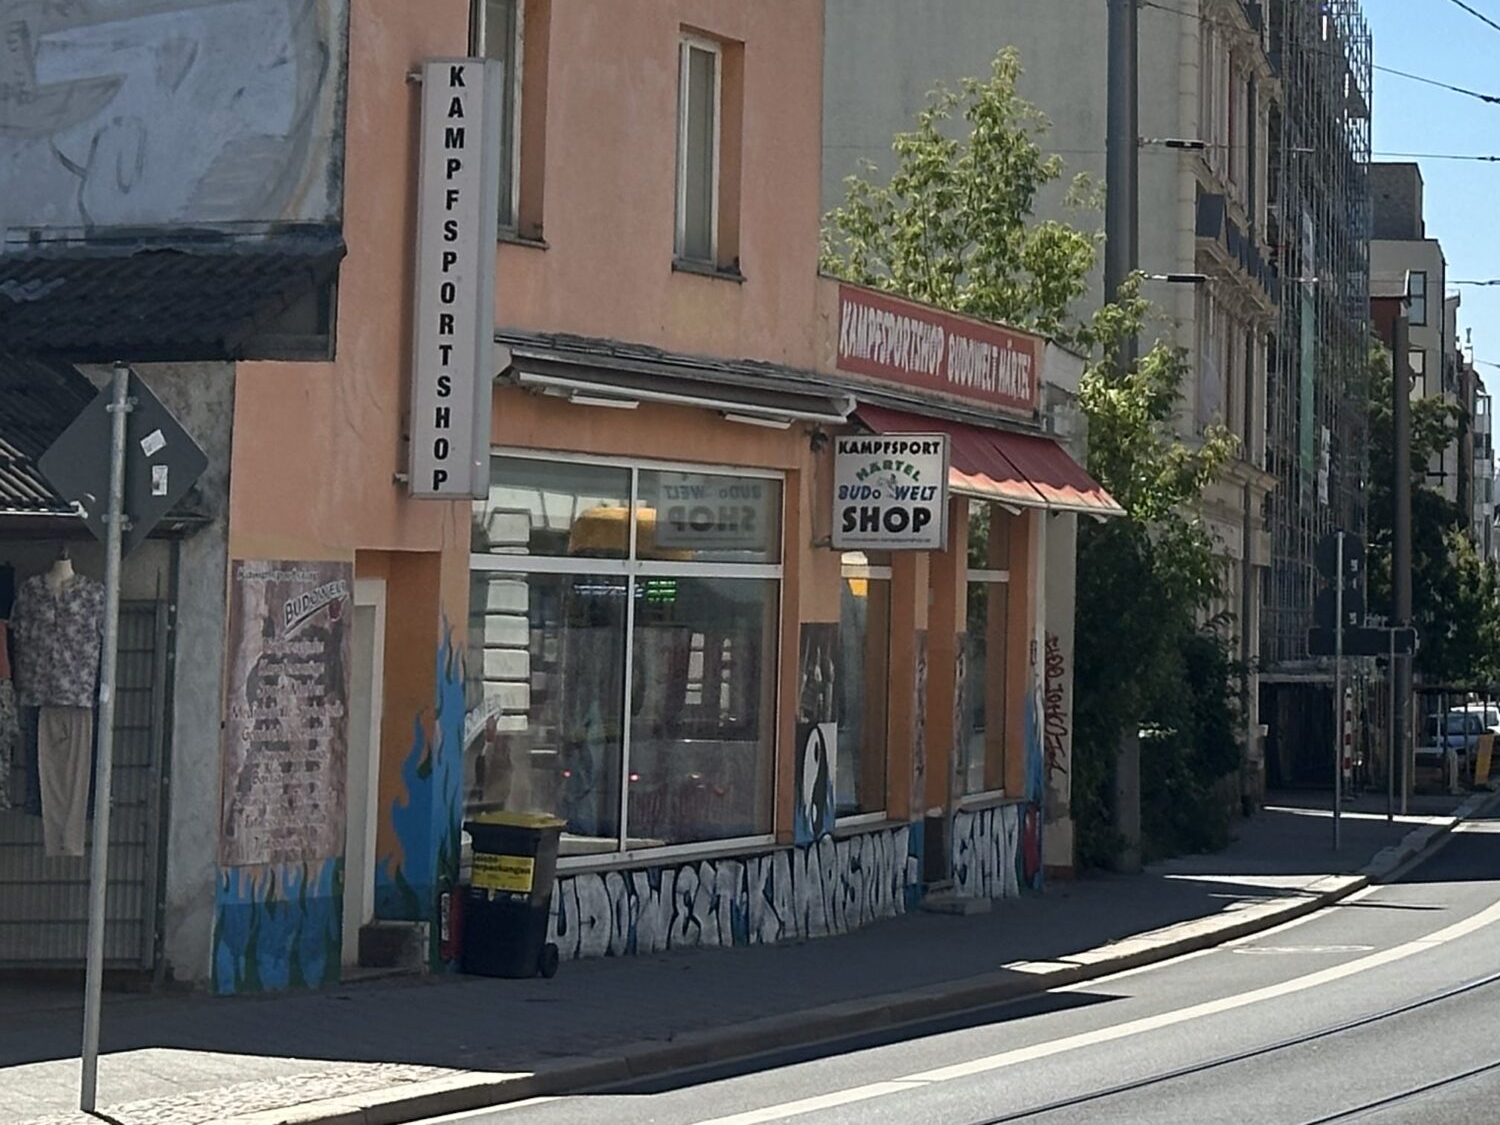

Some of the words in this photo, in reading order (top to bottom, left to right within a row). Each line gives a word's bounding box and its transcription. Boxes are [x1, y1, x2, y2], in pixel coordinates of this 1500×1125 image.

[431, 64, 465, 493] KAMPFSPORTSHOP
[839, 299, 944, 377] KAMPFSPORTSHOP
[838, 440, 941, 455] KAMPFSPORT
[894, 485, 938, 501] WELT
[842, 506, 932, 533] SHOP
